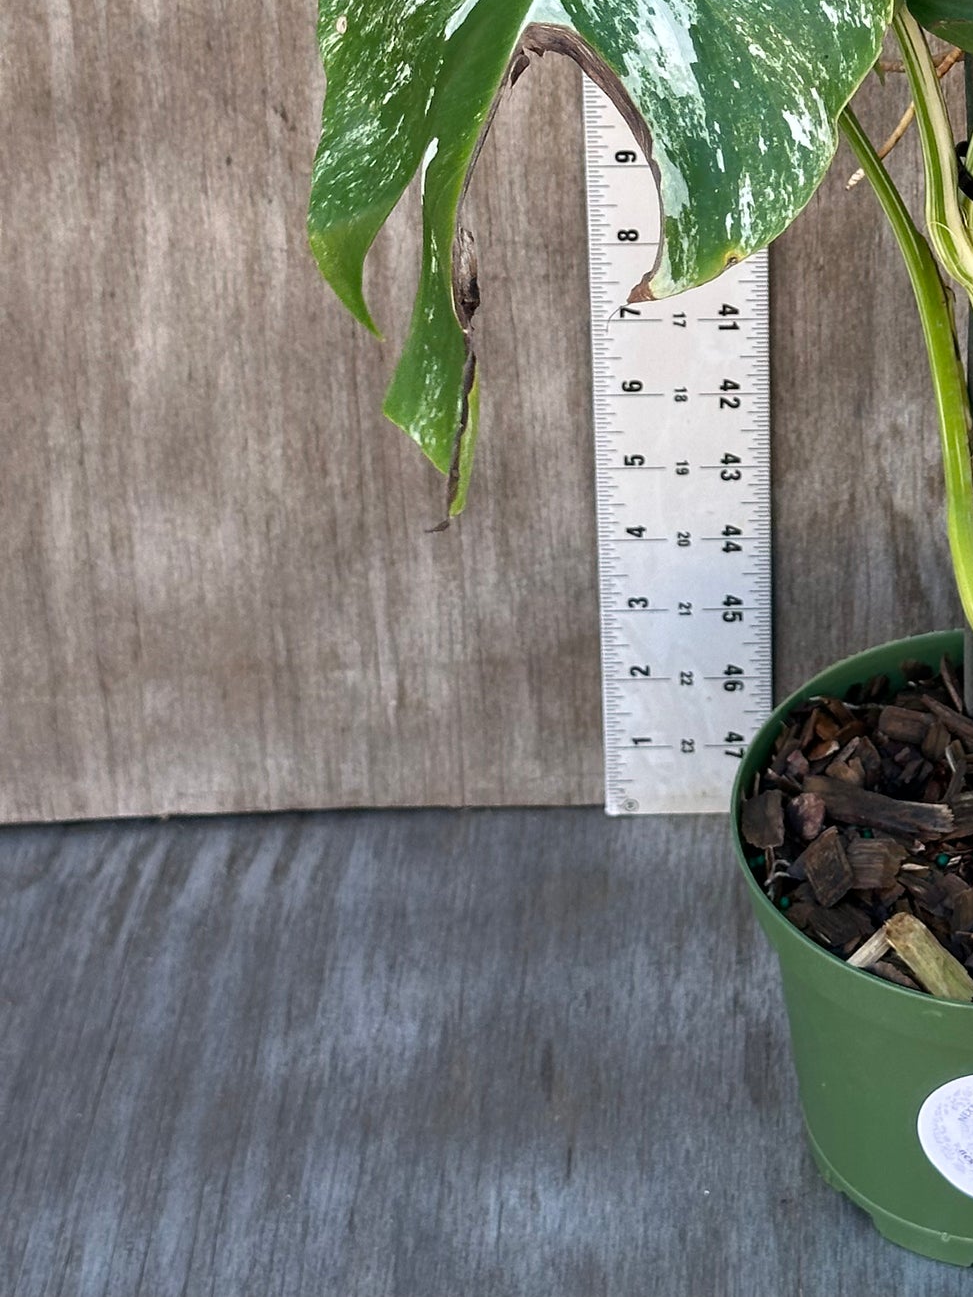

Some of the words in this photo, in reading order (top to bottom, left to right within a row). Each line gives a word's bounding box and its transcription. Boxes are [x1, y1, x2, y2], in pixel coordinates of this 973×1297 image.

[615, 151, 637, 163] 9
[617, 229, 639, 242] 8
[620, 306, 641, 318] 7
[672, 312, 687, 327] 17
[718, 303, 740, 331] 41
[622, 380, 643, 392] 6
[674, 387, 688, 402] 18
[719, 379, 741, 409] 42
[624, 454, 645, 466] 5
[676, 460, 689, 475] 19
[720, 453, 741, 481] 43
[626, 525, 646, 538] 4
[676, 531, 691, 547] 20
[721, 525, 743, 553] 44
[628, 596, 649, 608] 3
[678, 602, 692, 617] 21
[722, 595, 743, 623] 45
[630, 665, 651, 677] 2
[680, 671, 694, 686] 22
[723, 664, 744, 693] 46
[631, 737, 652, 745] 1
[681, 738, 695, 753] 23
[724, 731, 744, 759] 47
